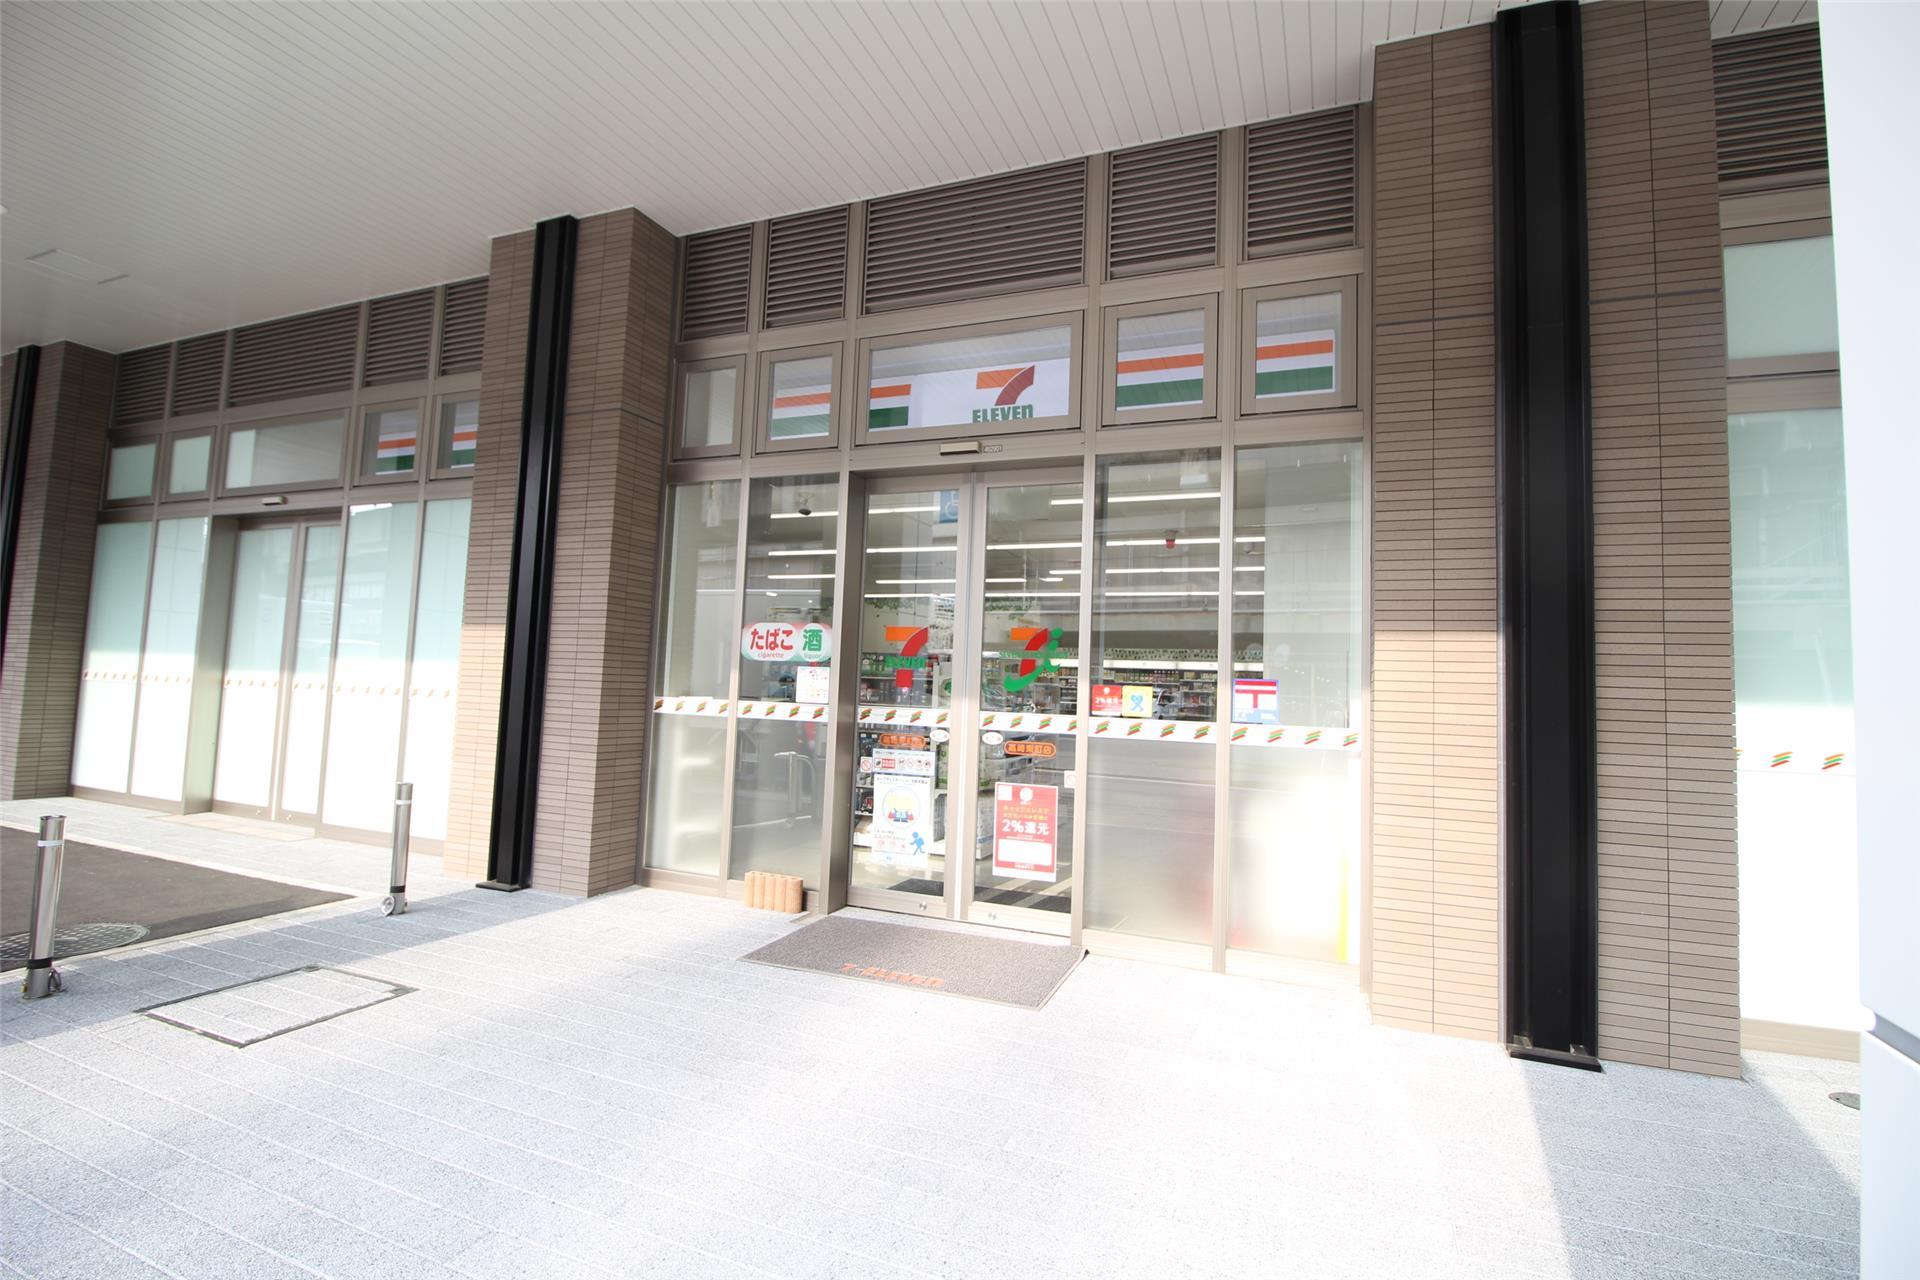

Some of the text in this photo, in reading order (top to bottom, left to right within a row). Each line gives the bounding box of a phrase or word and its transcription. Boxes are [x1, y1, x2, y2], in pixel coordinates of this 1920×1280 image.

[750, 628, 823, 651] たばこ 酒
[1002, 820, 1050, 835] 2%還元
